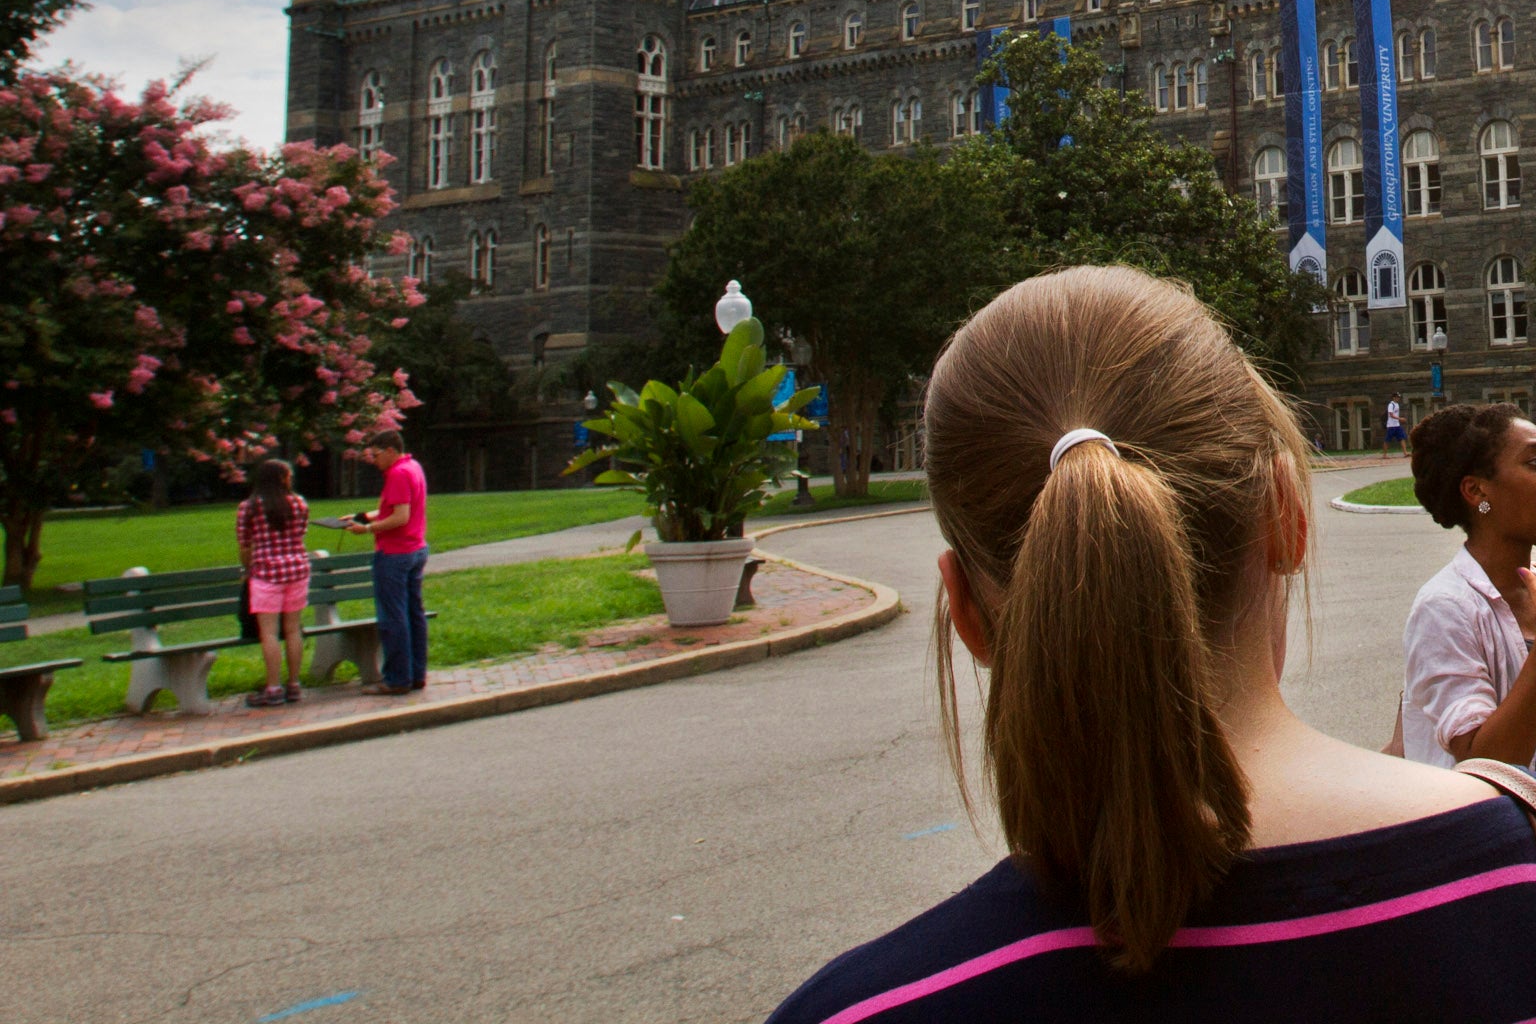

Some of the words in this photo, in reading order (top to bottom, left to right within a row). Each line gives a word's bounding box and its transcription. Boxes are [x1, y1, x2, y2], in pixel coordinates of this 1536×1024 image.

[1306, 57, 1316, 112] COUNTING
[1379, 45, 1393, 124] UNIVERSITY
[1309, 115, 1317, 143] STILL
[1309, 147, 1317, 169] AND
[1383, 123, 1400, 221] GEORGETOWN
[1311, 173, 1319, 215] BILLION
